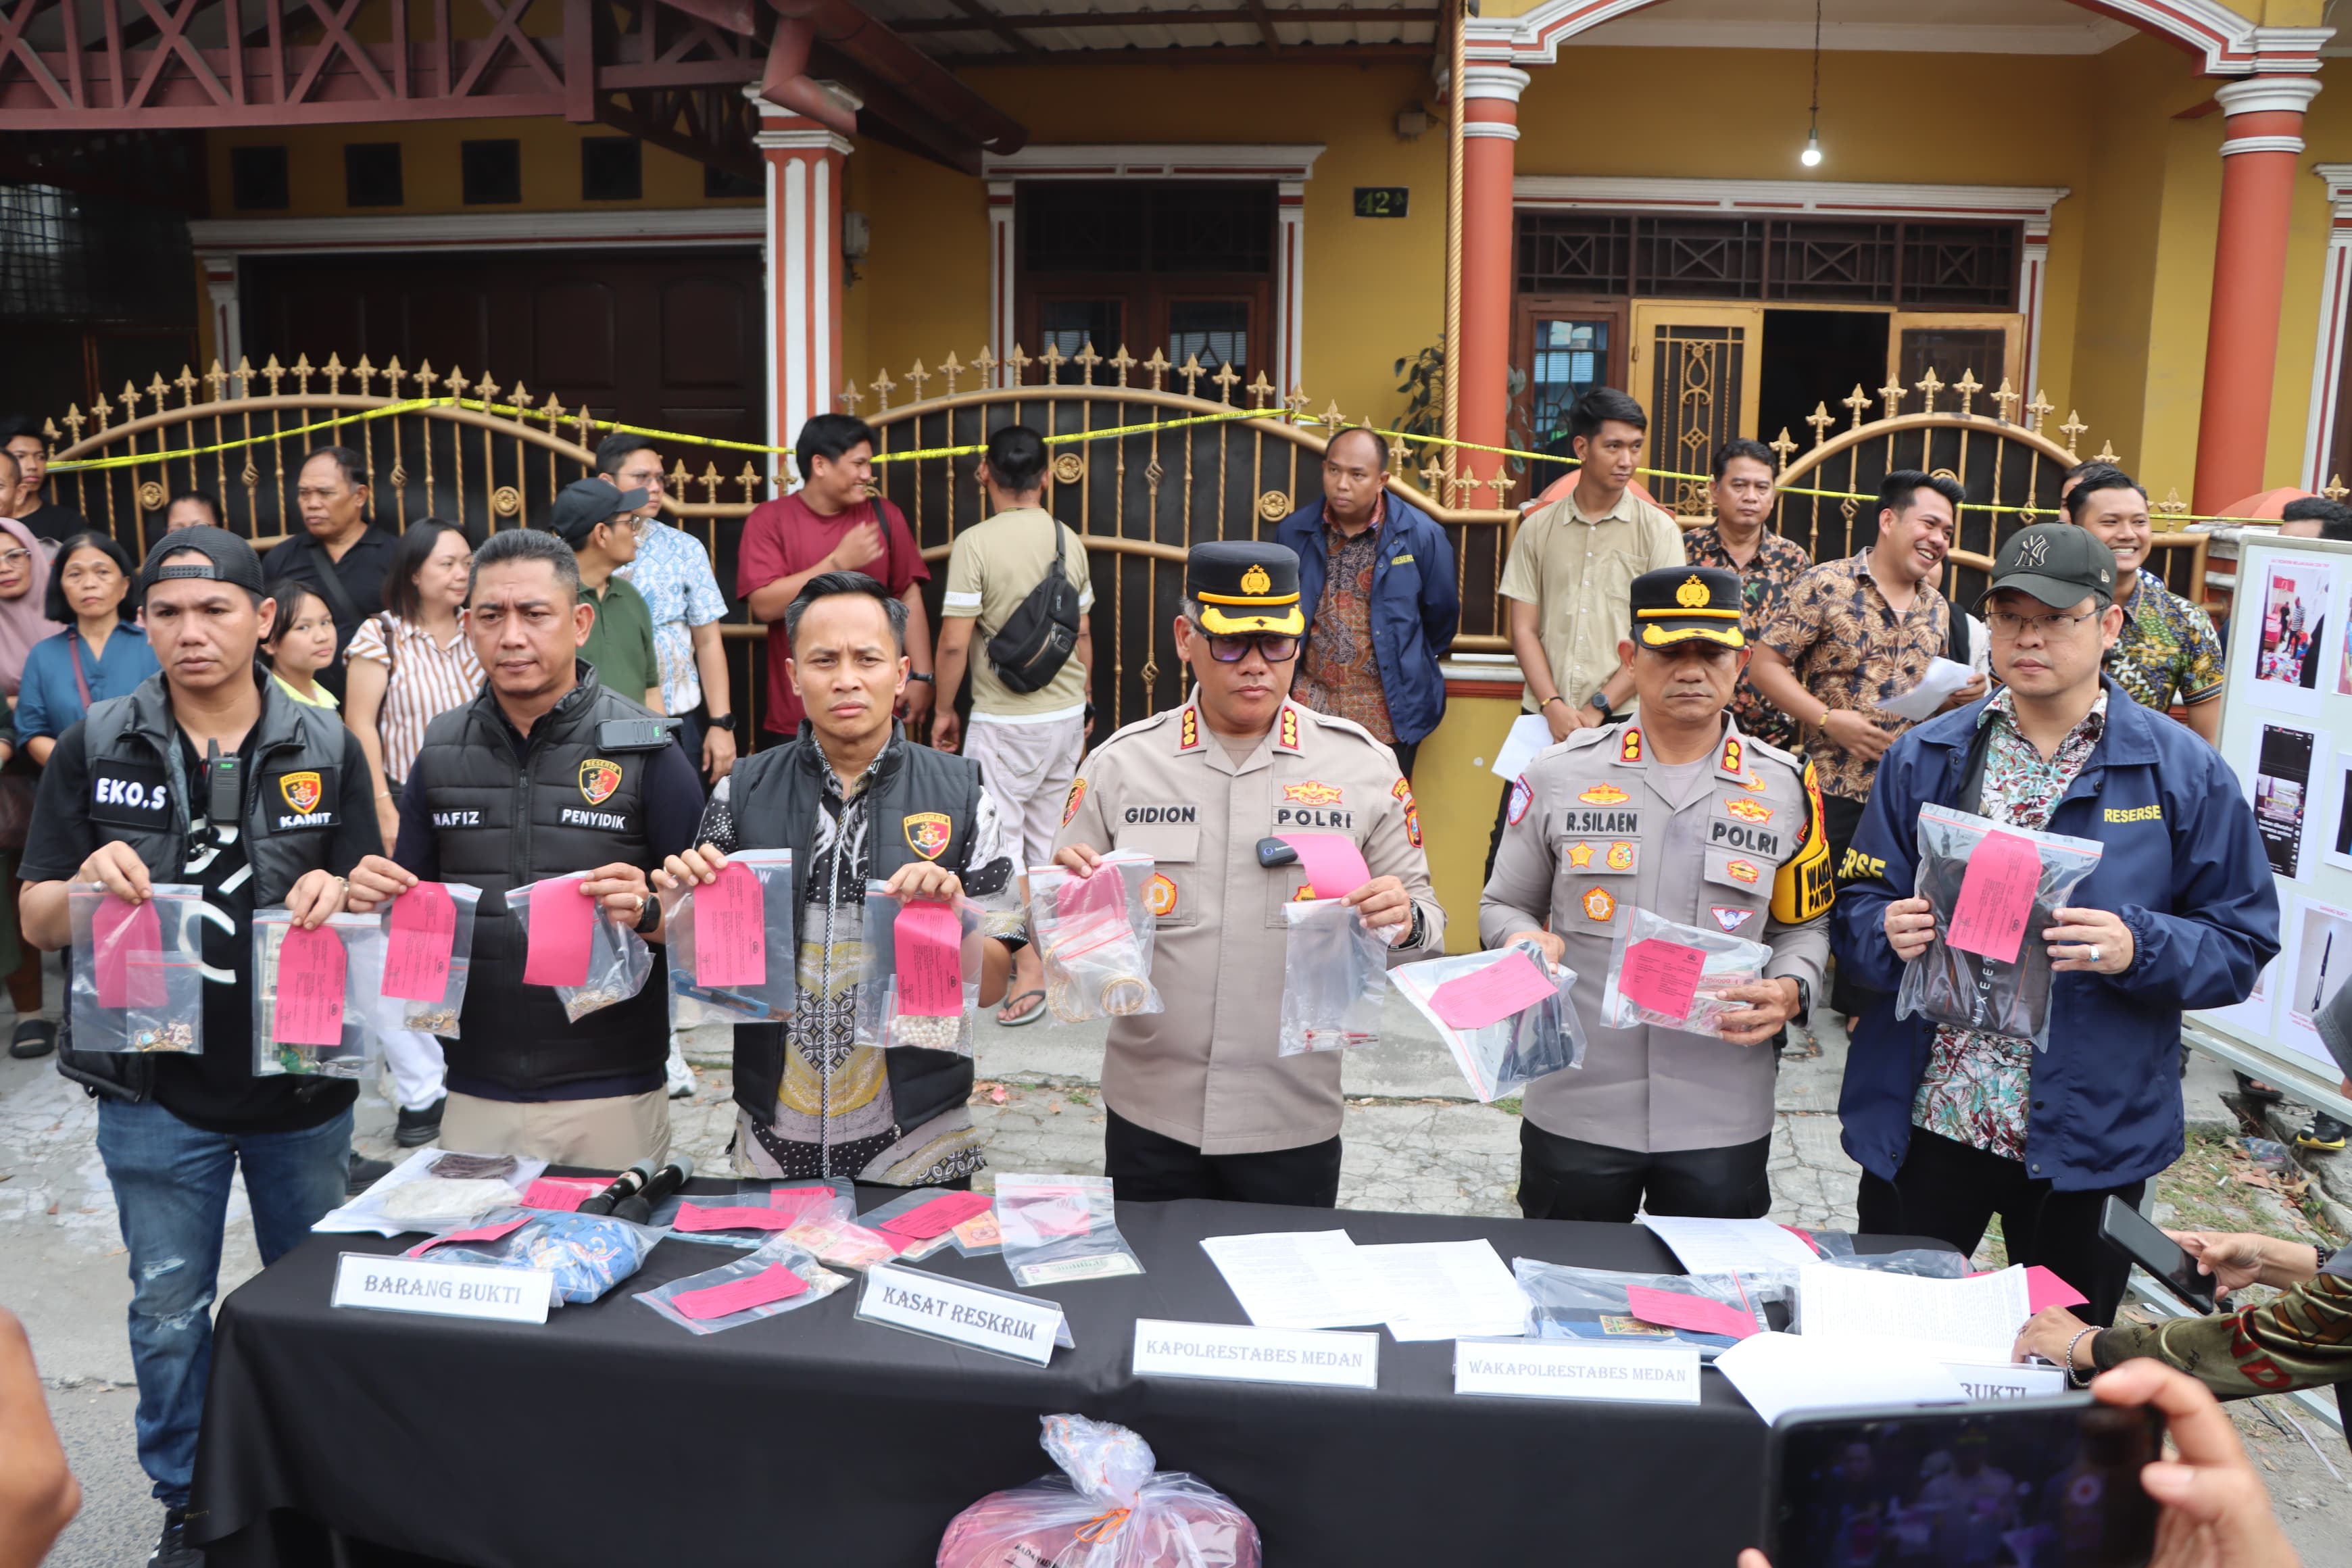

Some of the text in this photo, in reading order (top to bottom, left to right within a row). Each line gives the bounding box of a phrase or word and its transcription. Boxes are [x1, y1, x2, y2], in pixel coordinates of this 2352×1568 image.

[96, 777, 167, 810] EKO.S
[280, 812, 332, 828] KANIT
[562, 808, 626, 829] PENYIDIK
[1125, 806, 1196, 823] GIDION
[1277, 808, 1351, 829] POLRI
[1566, 812, 1638, 833] R.SILAEN
[2104, 804, 2161, 823] RESERSE
[1711, 821, 1778, 856] POLRI
[364, 1275, 521, 1304] BARANG BUKTI
[882, 1286, 1037, 1341] KASAT RESKRIM
[1146, 1340, 1363, 1368] KAPOLRESTABES MEDAN
[1469, 1360, 1686, 1382] WAKAPOLRESTABES MEDAN
